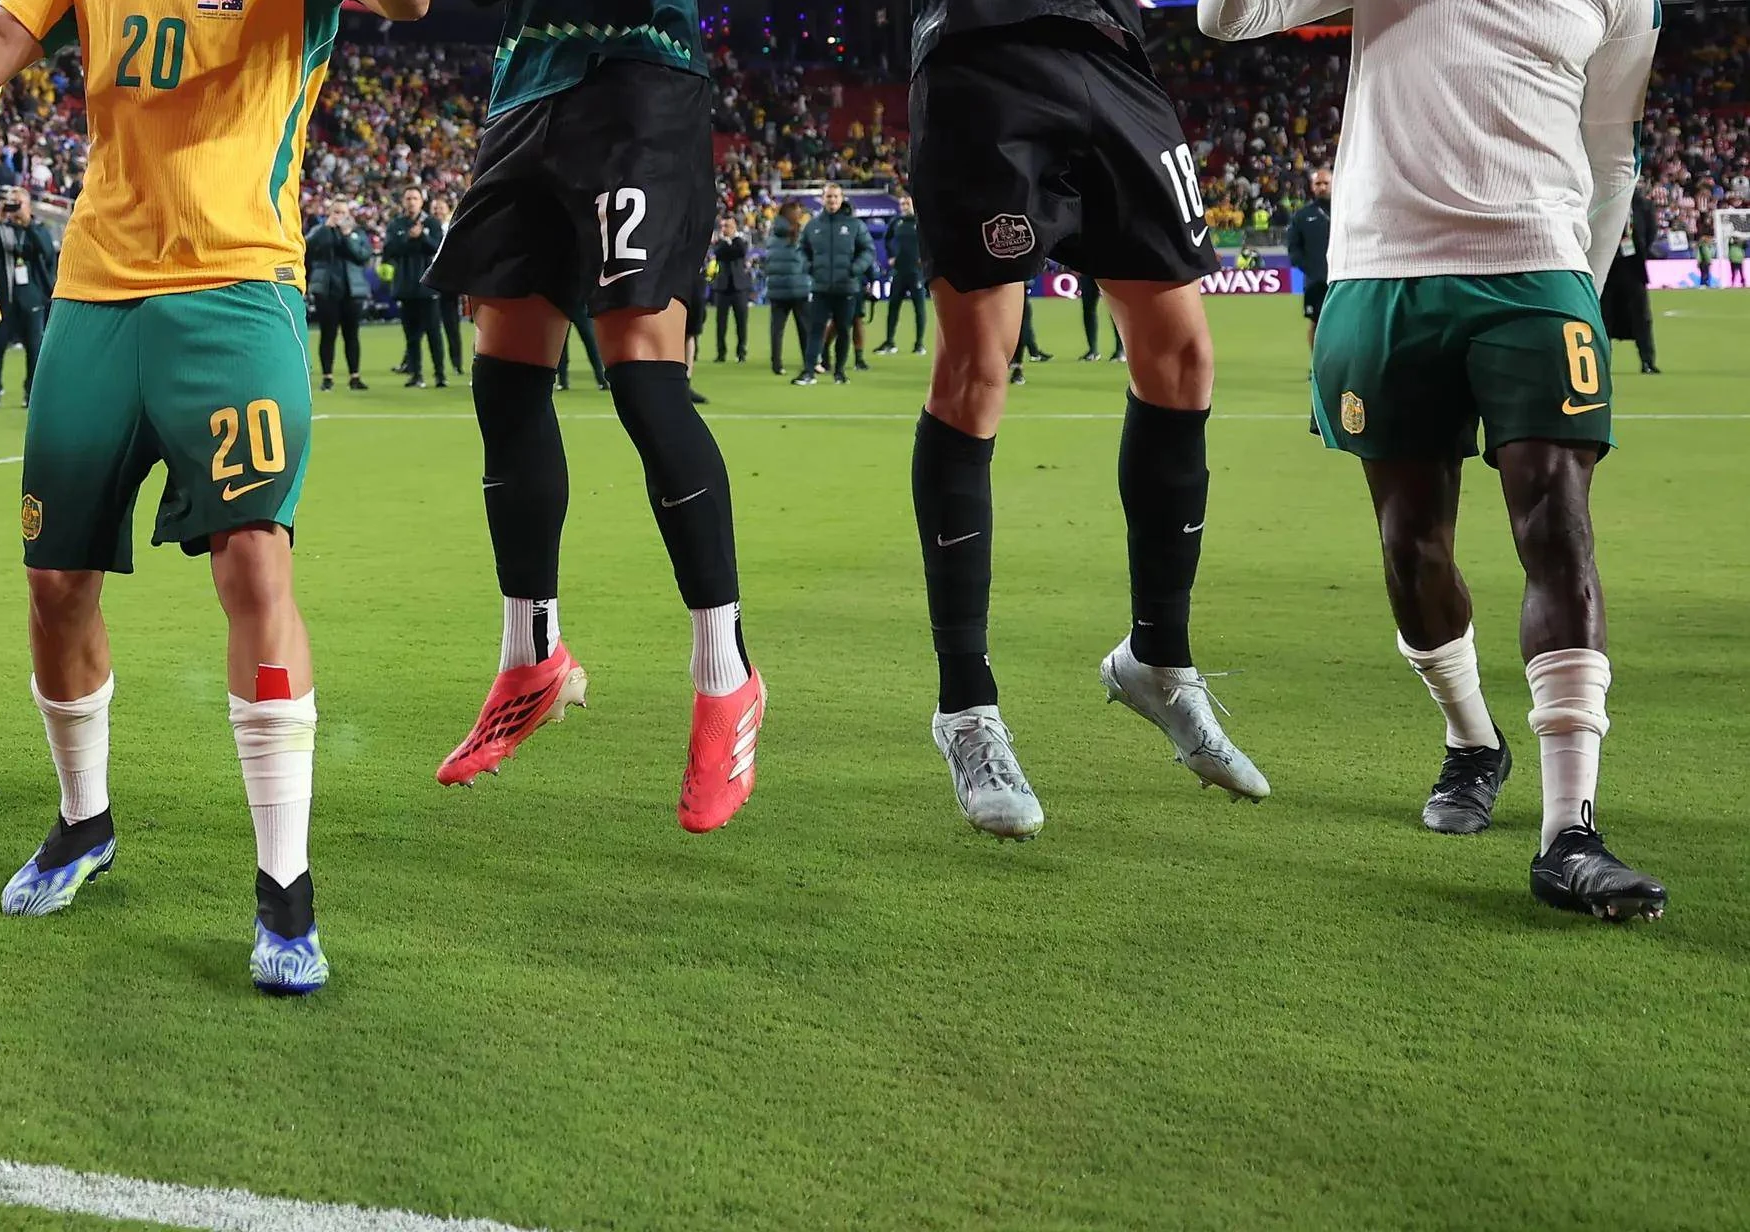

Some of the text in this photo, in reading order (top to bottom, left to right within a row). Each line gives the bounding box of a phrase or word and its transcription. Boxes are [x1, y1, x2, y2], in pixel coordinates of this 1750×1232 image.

[115, 15, 186, 89] 20
[1160, 143, 1204, 224] 18
[594, 187, 648, 263] 12
[1200, 269, 1281, 294] WAYS
[1562, 321, 1599, 395] 6
[208, 399, 288, 483] 20
